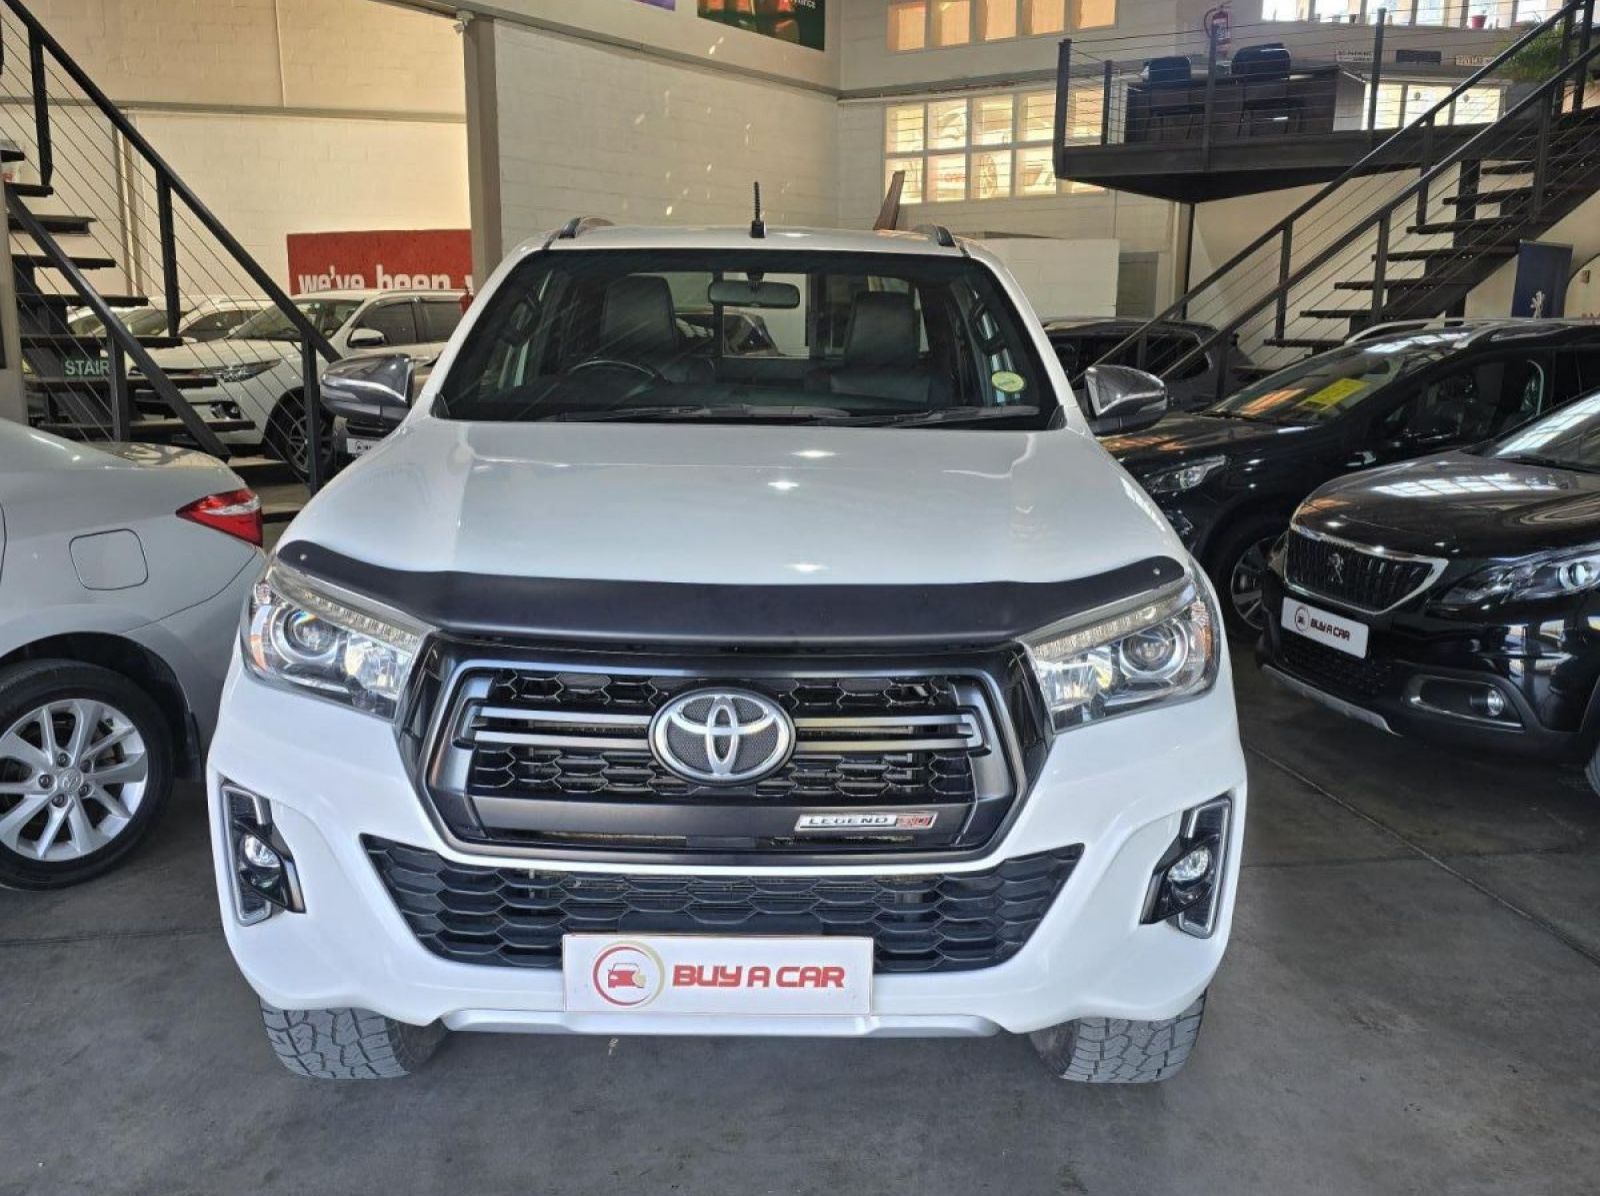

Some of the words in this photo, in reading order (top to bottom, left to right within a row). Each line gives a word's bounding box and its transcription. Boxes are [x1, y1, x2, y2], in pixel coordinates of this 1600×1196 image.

[1310, 618, 1326, 633] BUY
[1326, 625, 1333, 635] A
[1333, 627, 1351, 641] CAR
[808, 817, 889, 825] LEGEND
[672, 964, 742, 987] BUY
[746, 966, 770, 987] A
[776, 966, 845, 988] CAR
